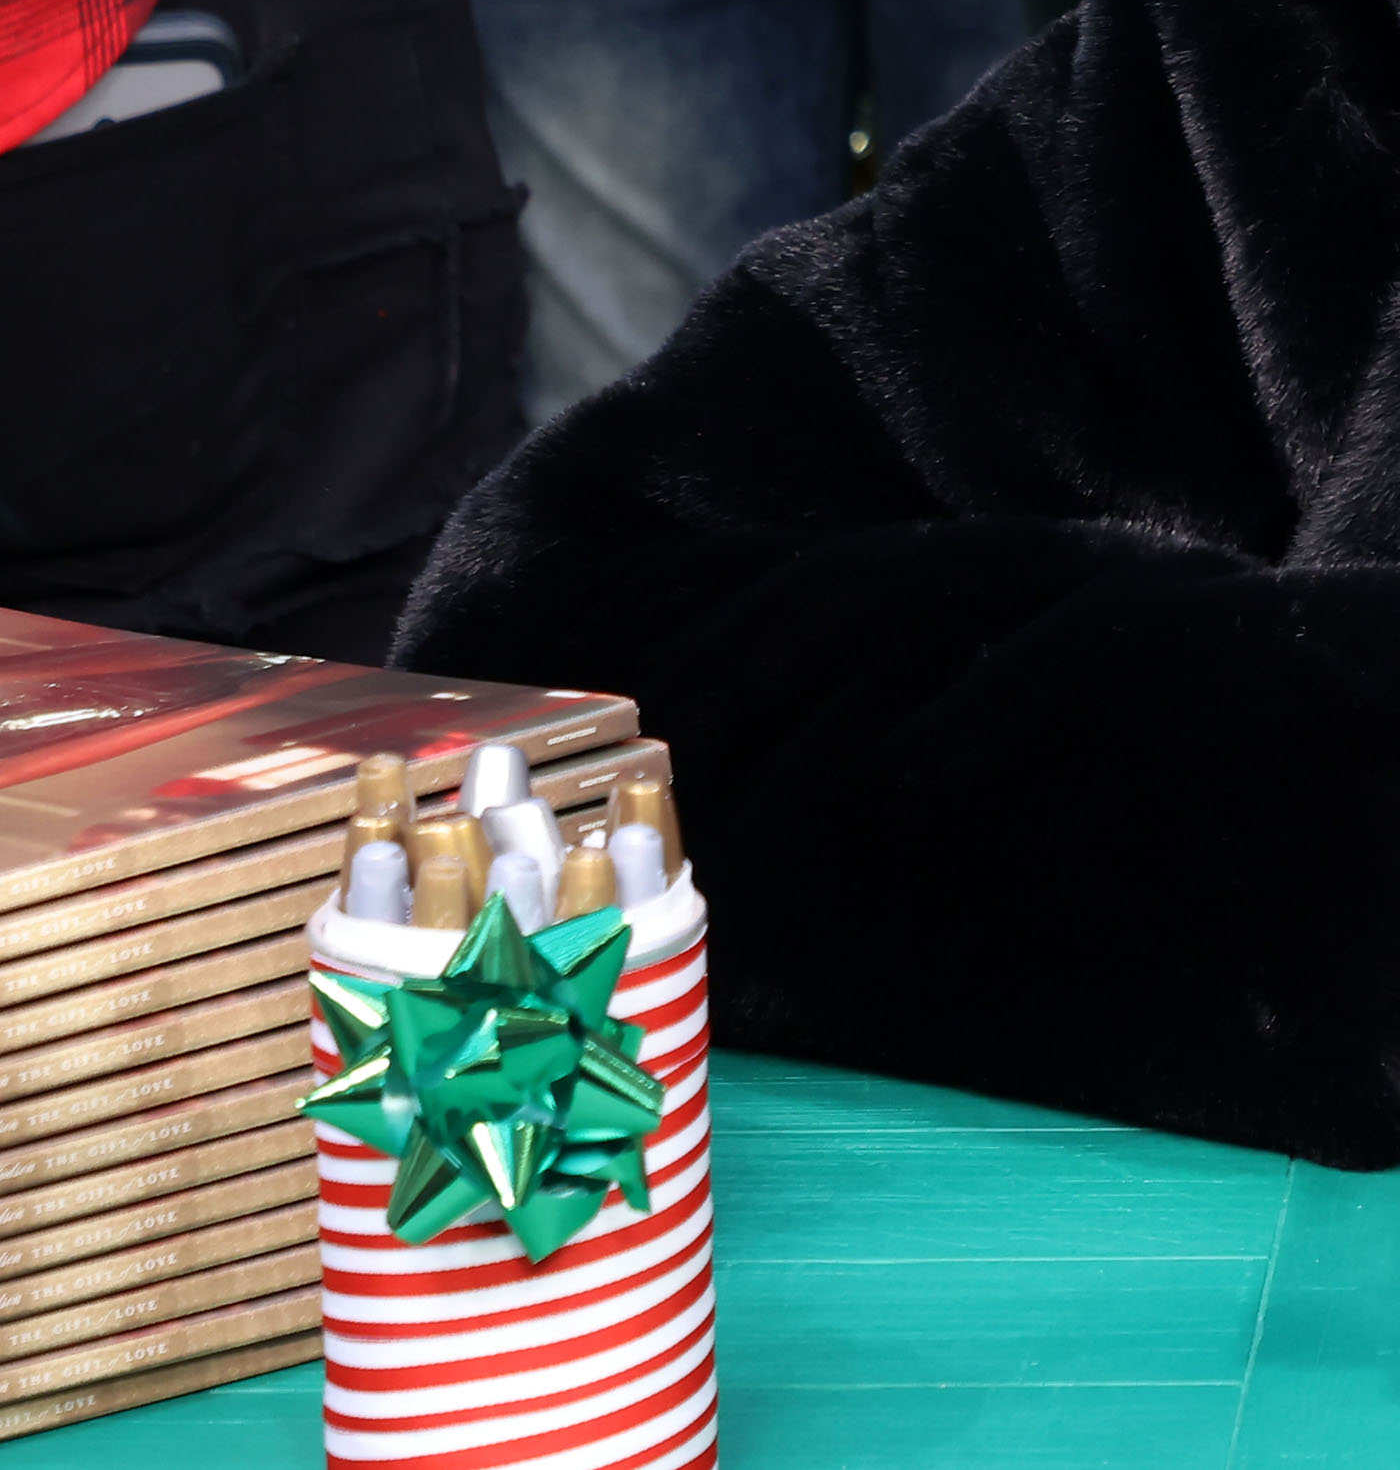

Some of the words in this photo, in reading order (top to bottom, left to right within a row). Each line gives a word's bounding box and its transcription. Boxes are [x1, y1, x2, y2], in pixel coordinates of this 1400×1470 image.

[73, 857, 116, 878] LOVE
[39, 916, 80, 937] GIFT
[103, 899, 147, 920] LOVE
[50, 960, 88, 979] GIFT
[109, 943, 153, 964] LOVE
[6, 1022, 38, 1039] THE
[48, 1007, 87, 1026] GIFT
[108, 990, 152, 1011] LOVE
[18, 1065, 54, 1083] THE
[60, 1051, 100, 1071] GIFT
[121, 1034, 166, 1055] LOVE
[27, 1110, 60, 1127] THE
[70, 1096, 109, 1114] GIFT
[131, 1078, 174, 1099] LOVE
[45, 1153, 78, 1170] THE
[87, 1138, 128, 1157] GIFT
[149, 1121, 193, 1142] LOVE
[33, 1198, 65, 1215] THE
[75, 1185, 116, 1203] GIFT
[136, 1167, 181, 1188] LOVE
[32, 1242, 64, 1259] THE
[75, 1228, 113, 1247] GIFT
[134, 1210, 178, 1231] LOVE
[32, 1284, 64, 1301] THE
[74, 1271, 113, 1290] GIFT
[135, 1252, 178, 1273] LOVE
[9, 1330, 42, 1347] THE
[53, 1316, 92, 1335] GIFT
[114, 1298, 158, 1320] LOVE
[19, 1370, 53, 1388] THE
[62, 1359, 101, 1377] GIFT
[123, 1342, 169, 1363] LOVE
[0, 1412, 32, 1429] IFT
[55, 1395, 97, 1415] LOVE
